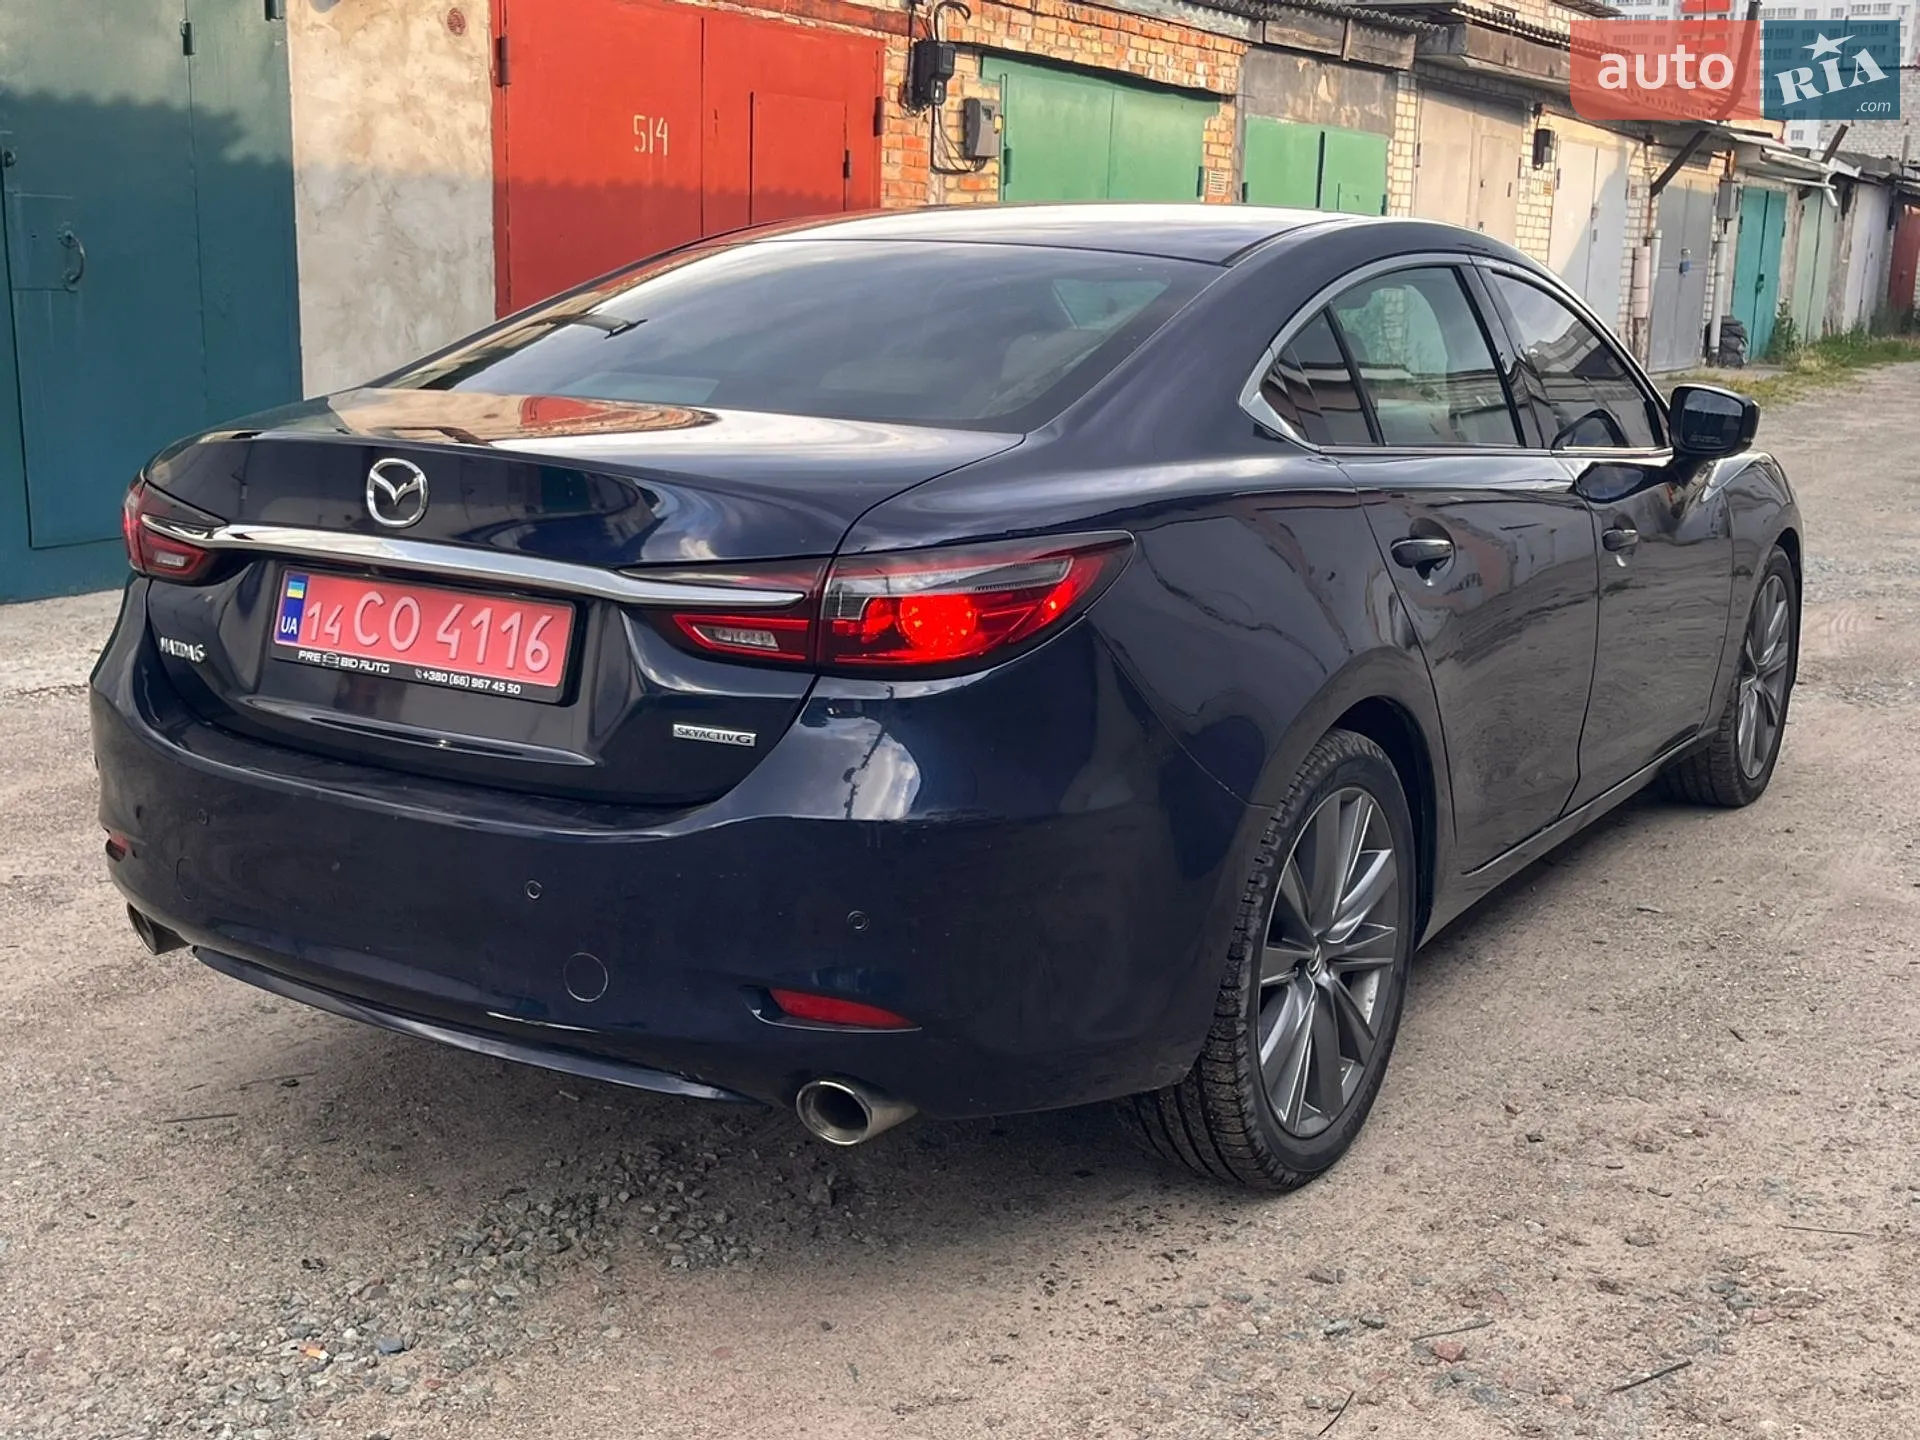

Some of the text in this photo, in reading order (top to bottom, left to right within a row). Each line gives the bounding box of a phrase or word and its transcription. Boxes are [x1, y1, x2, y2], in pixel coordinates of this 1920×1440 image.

[633, 114, 668, 156] 514
[281, 615, 298, 635] UA
[307, 591, 552, 673] 14 CO 4116
[298, 650, 322, 663] PRE
[359, 660, 391, 674] AUTO
[422, 670, 448, 683] +380
[492, 681, 505, 692] 45
[506, 684, 521, 695] 50
